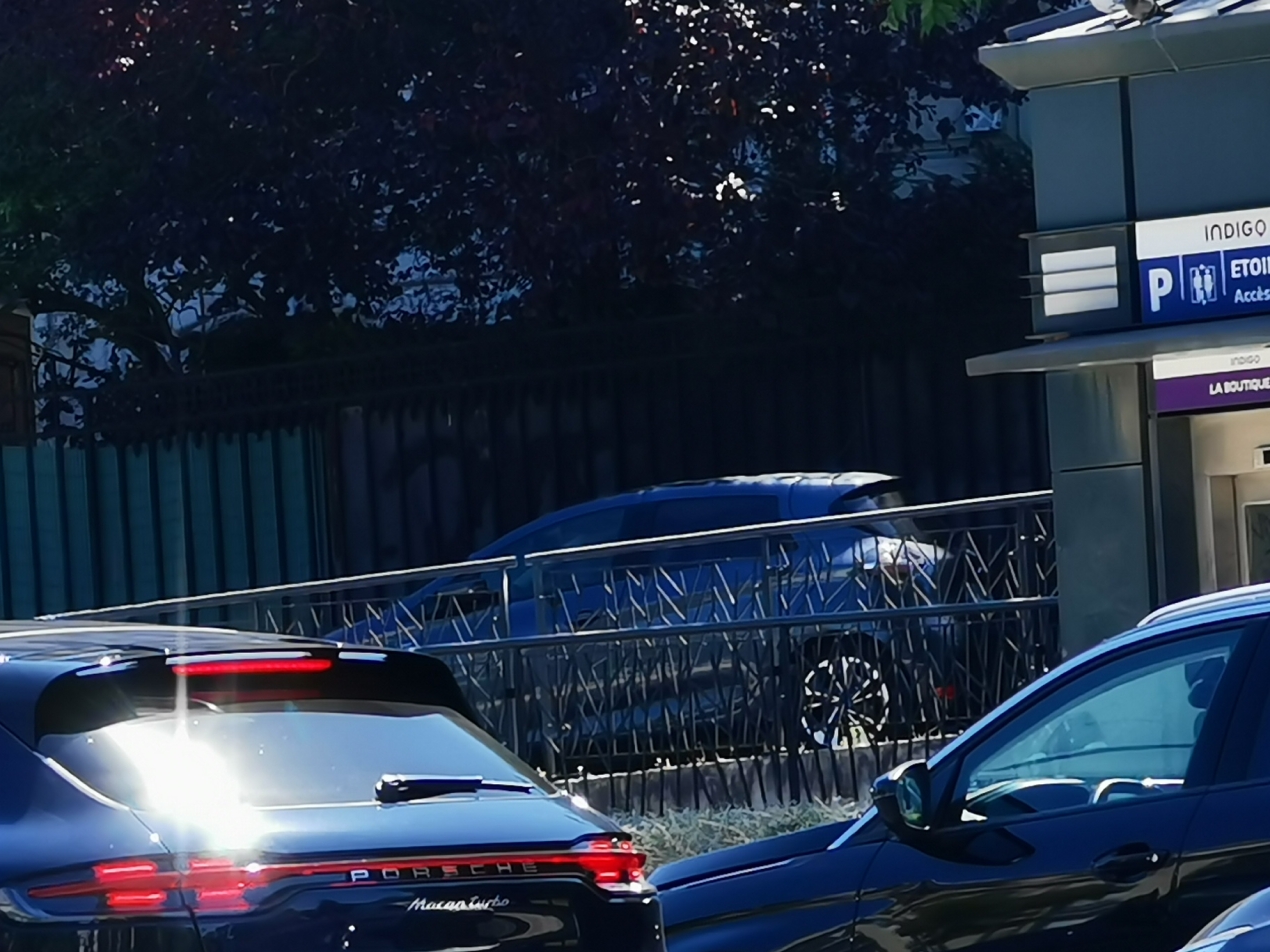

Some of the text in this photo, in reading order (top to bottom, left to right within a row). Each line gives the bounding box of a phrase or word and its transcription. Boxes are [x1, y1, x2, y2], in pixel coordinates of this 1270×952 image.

[1205, 219, 1266, 241] INDIGO
[1148, 268, 1173, 312] P
[1209, 382, 1223, 396] LA
[350, 862, 538, 882] PORSCHE
[407, 897, 468, 912] Macan
